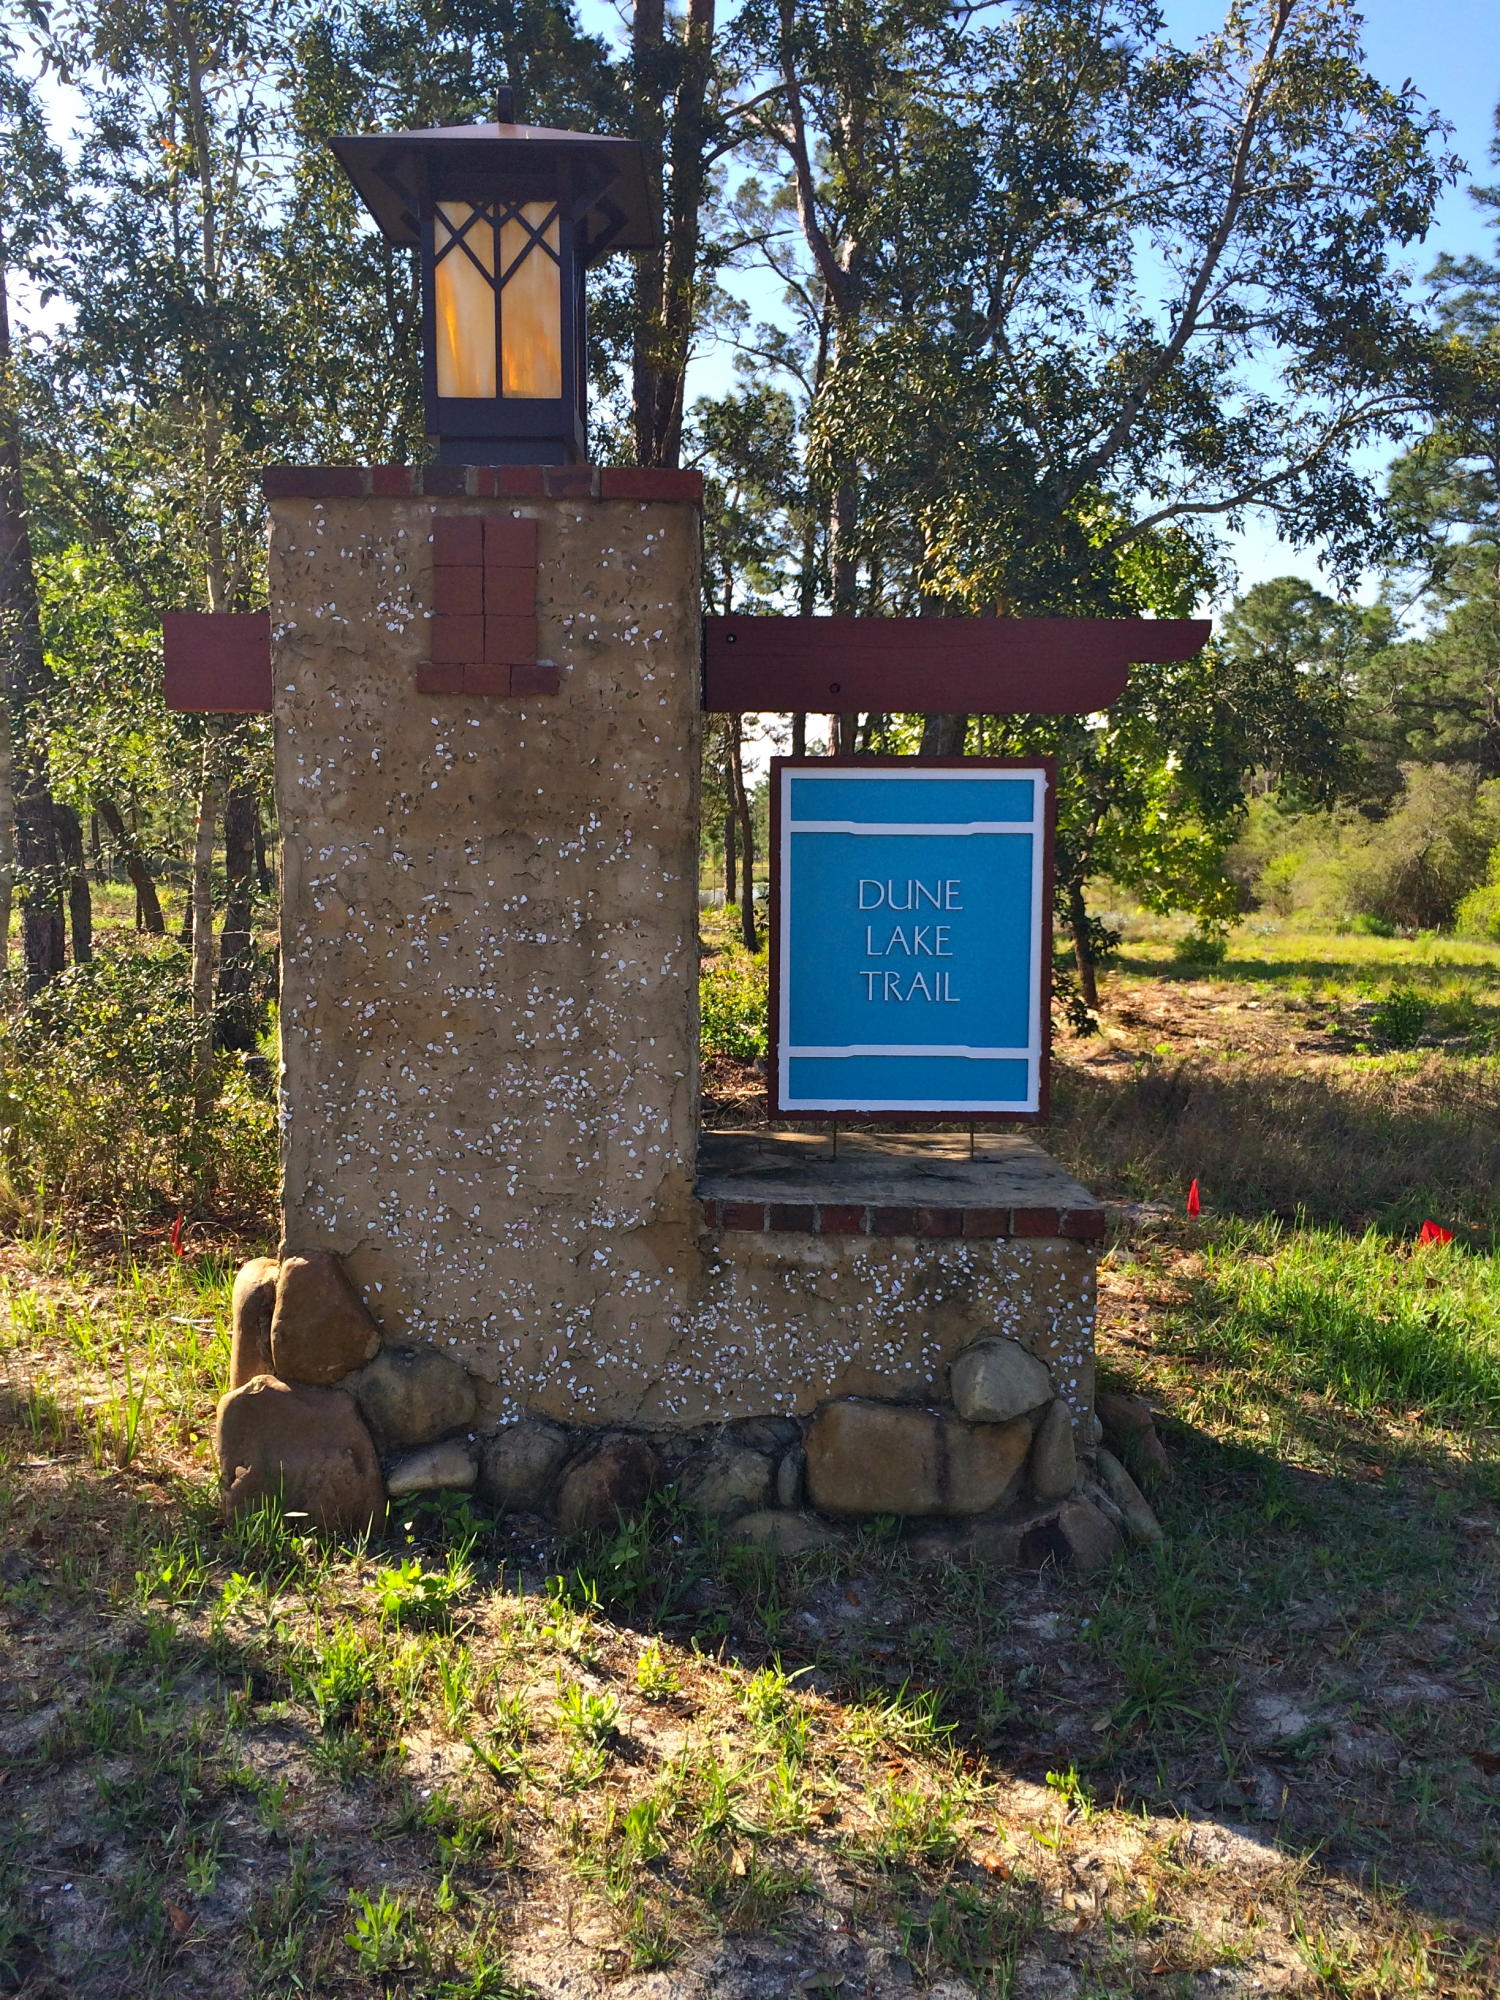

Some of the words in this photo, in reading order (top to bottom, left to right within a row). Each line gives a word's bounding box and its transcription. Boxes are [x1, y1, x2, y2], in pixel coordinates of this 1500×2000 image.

[858, 879, 963, 910] DUNE
[866, 925, 953, 956] LAKE
[860, 971, 960, 1002] TRAIL
